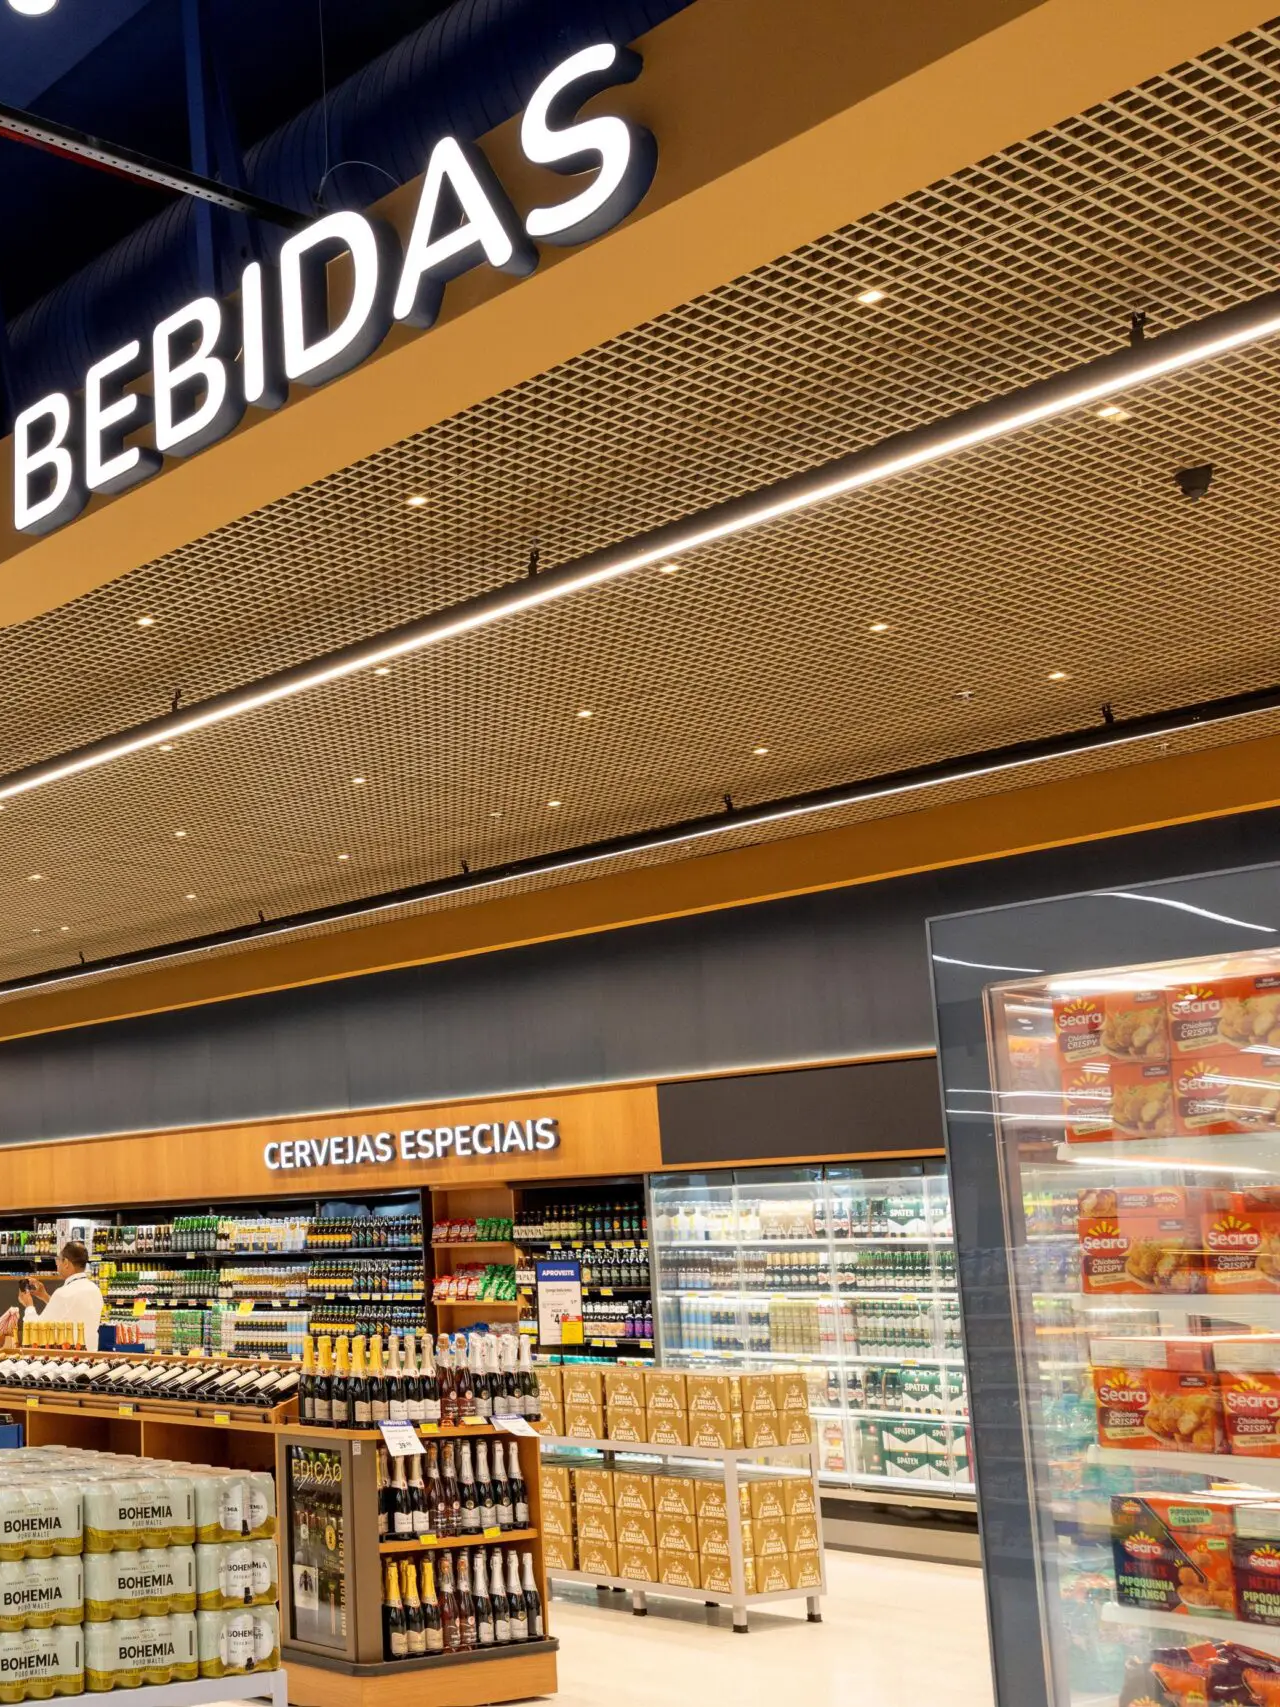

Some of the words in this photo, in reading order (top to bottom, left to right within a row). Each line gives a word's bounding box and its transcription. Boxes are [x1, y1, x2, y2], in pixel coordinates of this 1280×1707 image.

[14, 43, 634, 532] BEBIDAS
[1172, 1000, 1220, 1014] Seara
[1059, 1012, 1101, 1027] Seara
[1180, 1026, 1214, 1038] CRISPY
[1067, 1039, 1098, 1050] CRISPY
[264, 1132, 394, 1169] CERVEJAS
[400, 1118, 557, 1160] ESPECIAIS
[890, 1209, 914, 1217] SPATEN
[1084, 1237, 1128, 1249] Seara
[1208, 1232, 1258, 1246] Seara
[1092, 1264, 1122, 1272] CRISPY
[1217, 1261, 1254, 1270] CRISPY
[904, 1383, 929, 1392] SPATEN
[1100, 1387, 1147, 1403] Seara
[1227, 1392, 1279, 1408] Seara
[1109, 1417, 1141, 1426] CRISPY
[1236, 1424, 1272, 1433] CRISPY
[292, 1458, 342, 1482] EDIÇÃO
[118, 1506, 172, 1520] BOHEMIA
[4, 1517, 62, 1533] BOHEMIA
[1124, 1540, 1161, 1553] Seara
[1249, 1554, 1280, 1568] Sear
[118, 1574, 174, 1589] BOHEMIA
[1118, 1576, 1175, 1591] PIPOQUINHA
[4, 1587, 62, 1605] BOHEMIA
[1130, 1588, 1166, 1601] FRANGO
[1243, 1591, 1280, 1605] PIPOQU
[1255, 1604, 1280, 1616] FRAN
[119, 1642, 175, 1659] BOHEMIA
[1, 1653, 59, 1671] BOHEMIA
